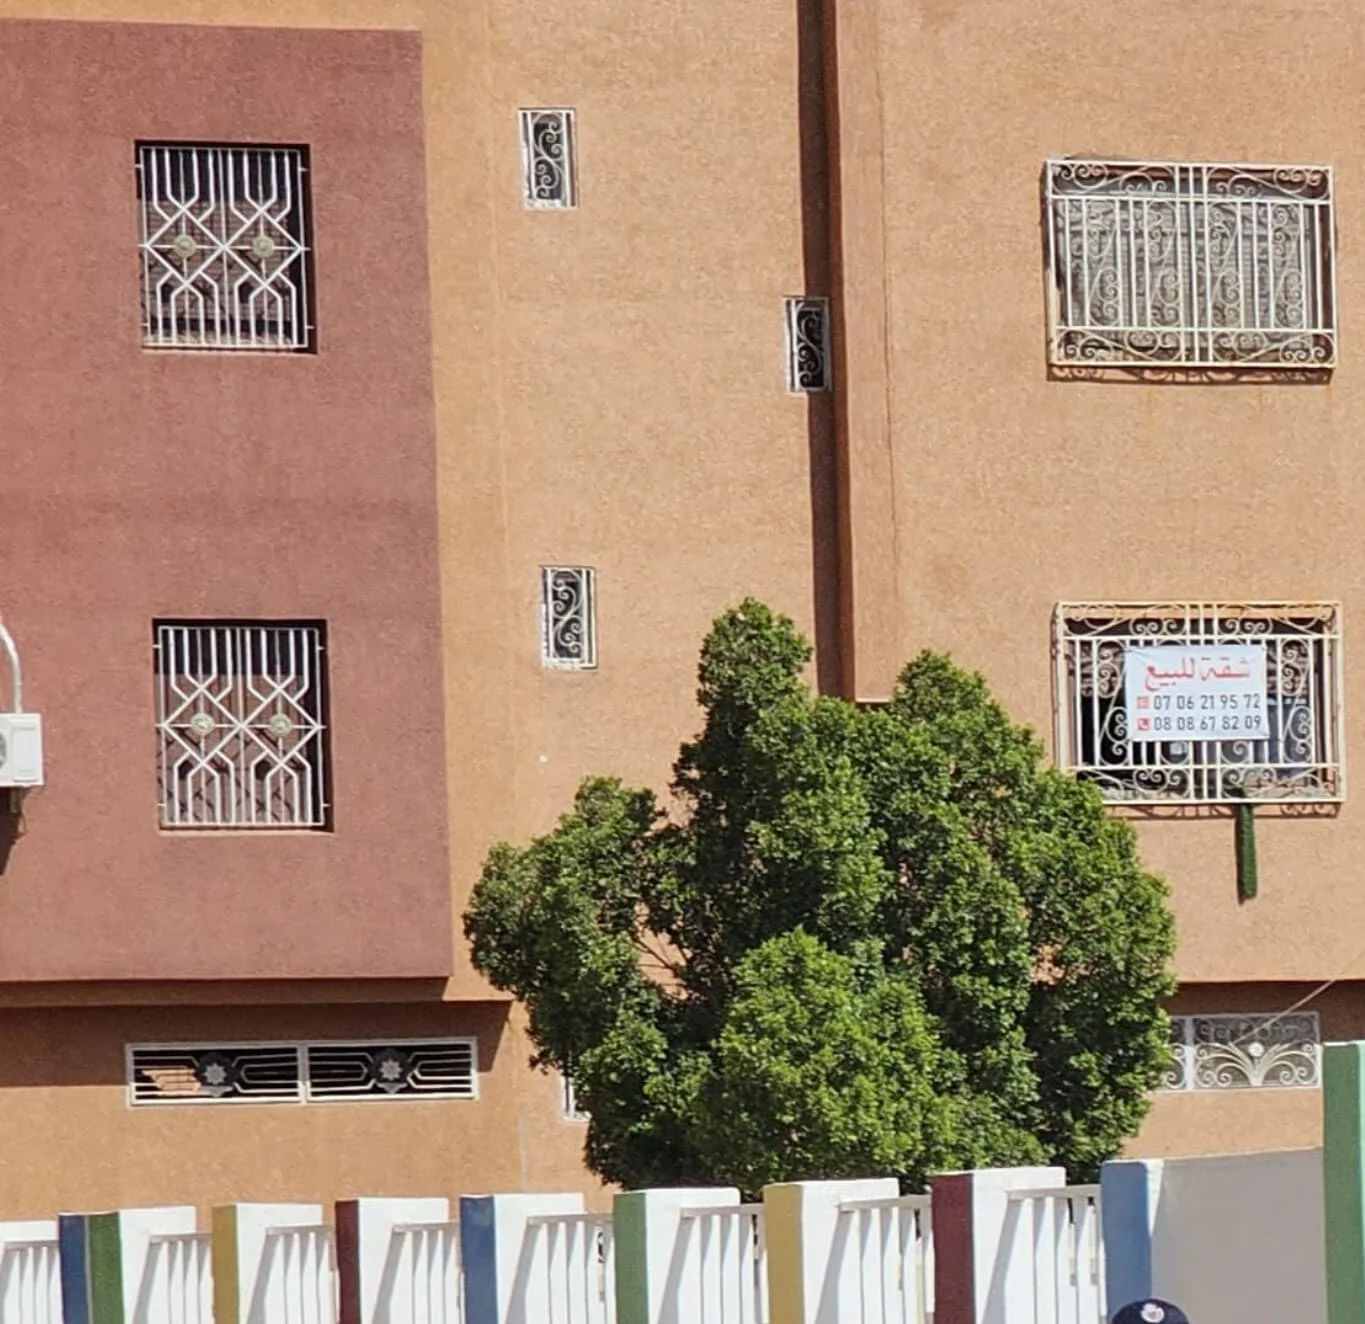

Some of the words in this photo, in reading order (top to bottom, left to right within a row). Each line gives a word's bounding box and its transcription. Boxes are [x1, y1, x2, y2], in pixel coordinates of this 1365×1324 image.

[1145, 657, 1195, 692] للبيع
[1200, 657, 1250, 682] شقة
[1154, 695, 1171, 710] 07
[1177, 695, 1194, 710] 06
[1200, 695, 1215, 710] 21
[1220, 694, 1238, 709] 95
[1243, 693, 1261, 709] 72
[1154, 717, 1172, 731] 08
[1177, 717, 1195, 731] 08
[1200, 716, 1216, 731] 67
[1244, 715, 1262, 730] 09
